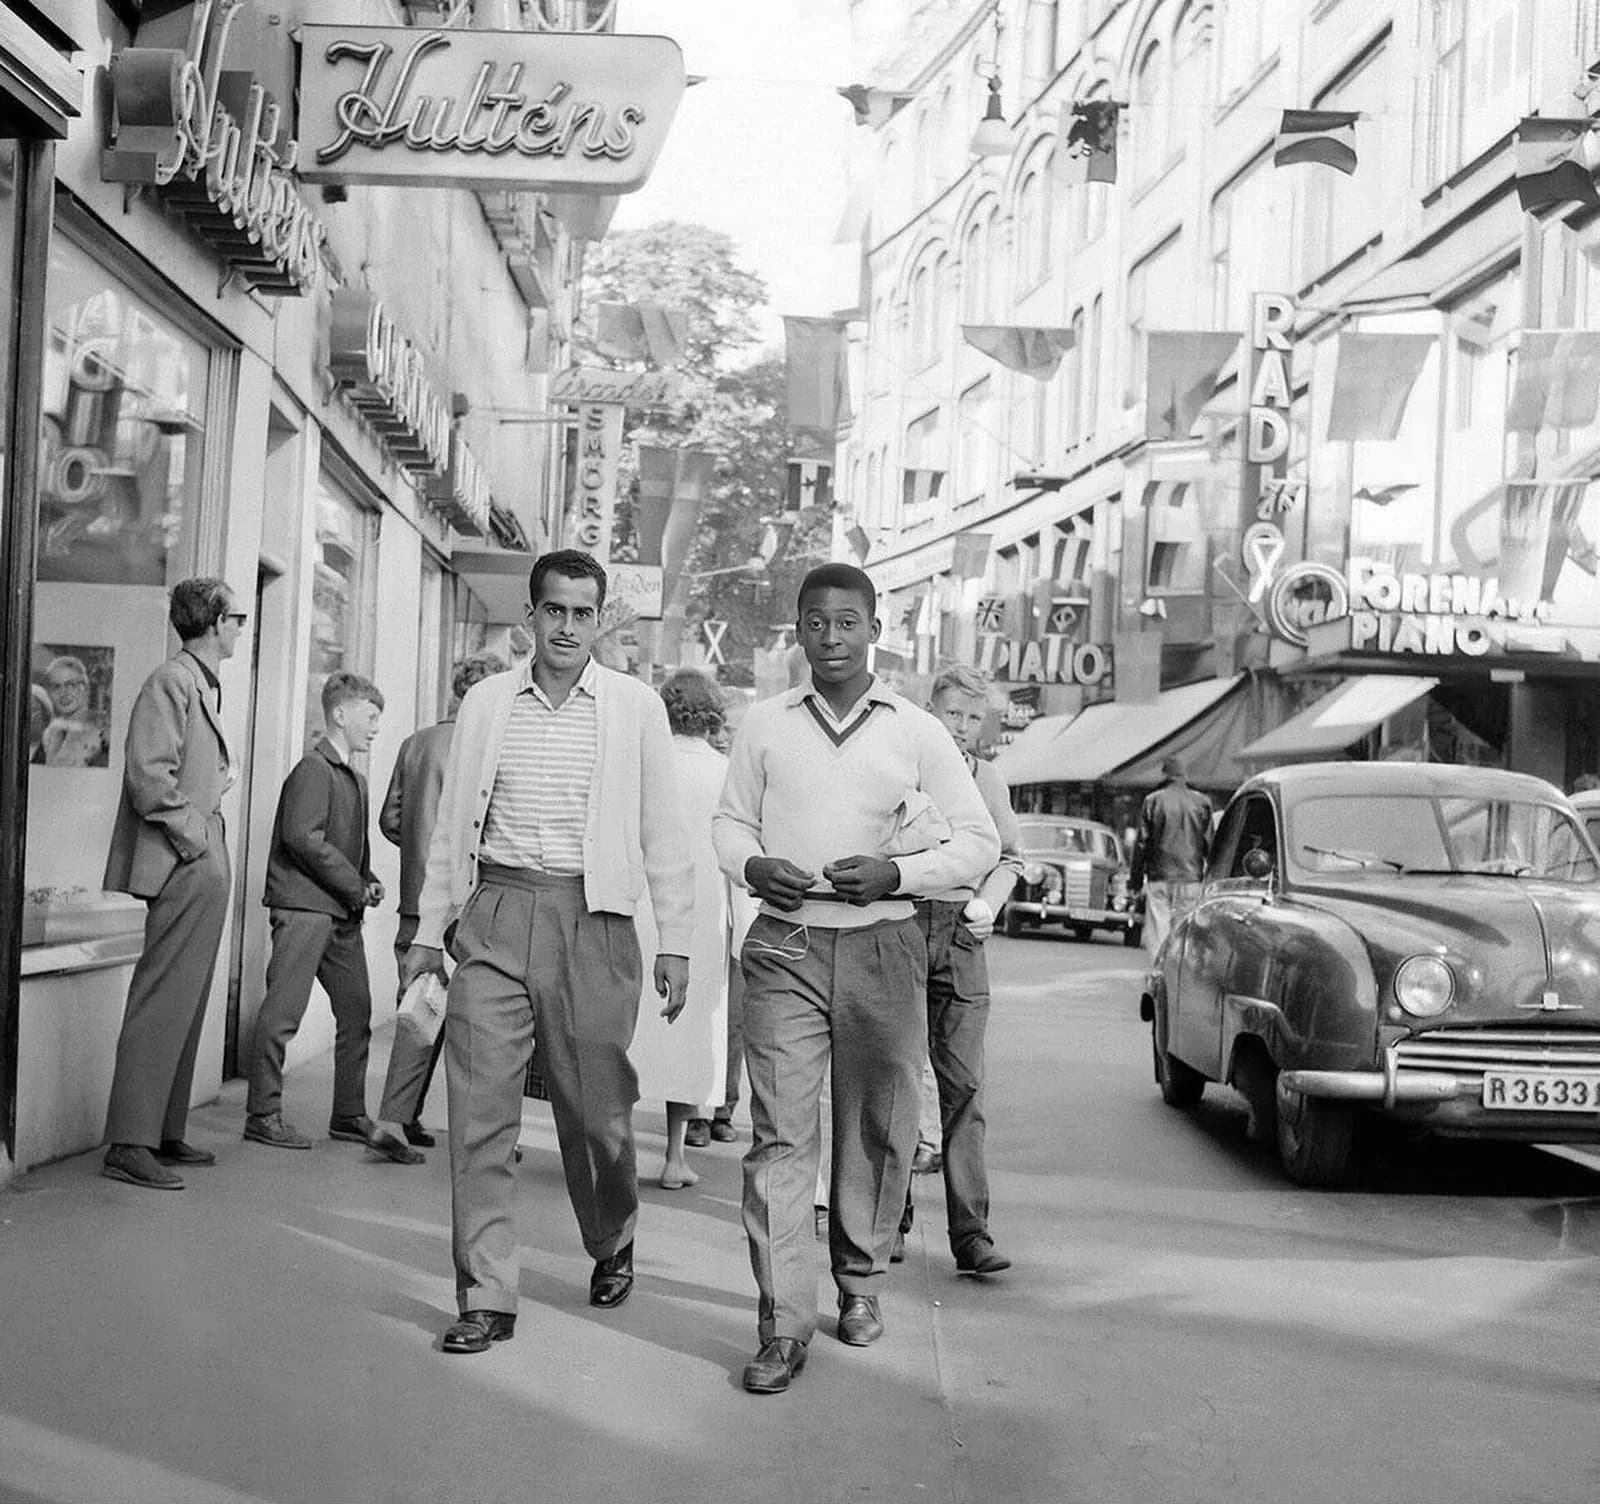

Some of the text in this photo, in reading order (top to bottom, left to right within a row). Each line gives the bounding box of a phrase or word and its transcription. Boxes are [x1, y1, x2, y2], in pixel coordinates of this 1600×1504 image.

[316, 32, 646, 164] Hulténs
[1242, 292, 1296, 578] RADIO
[1351, 611, 1490, 656] PIANO
